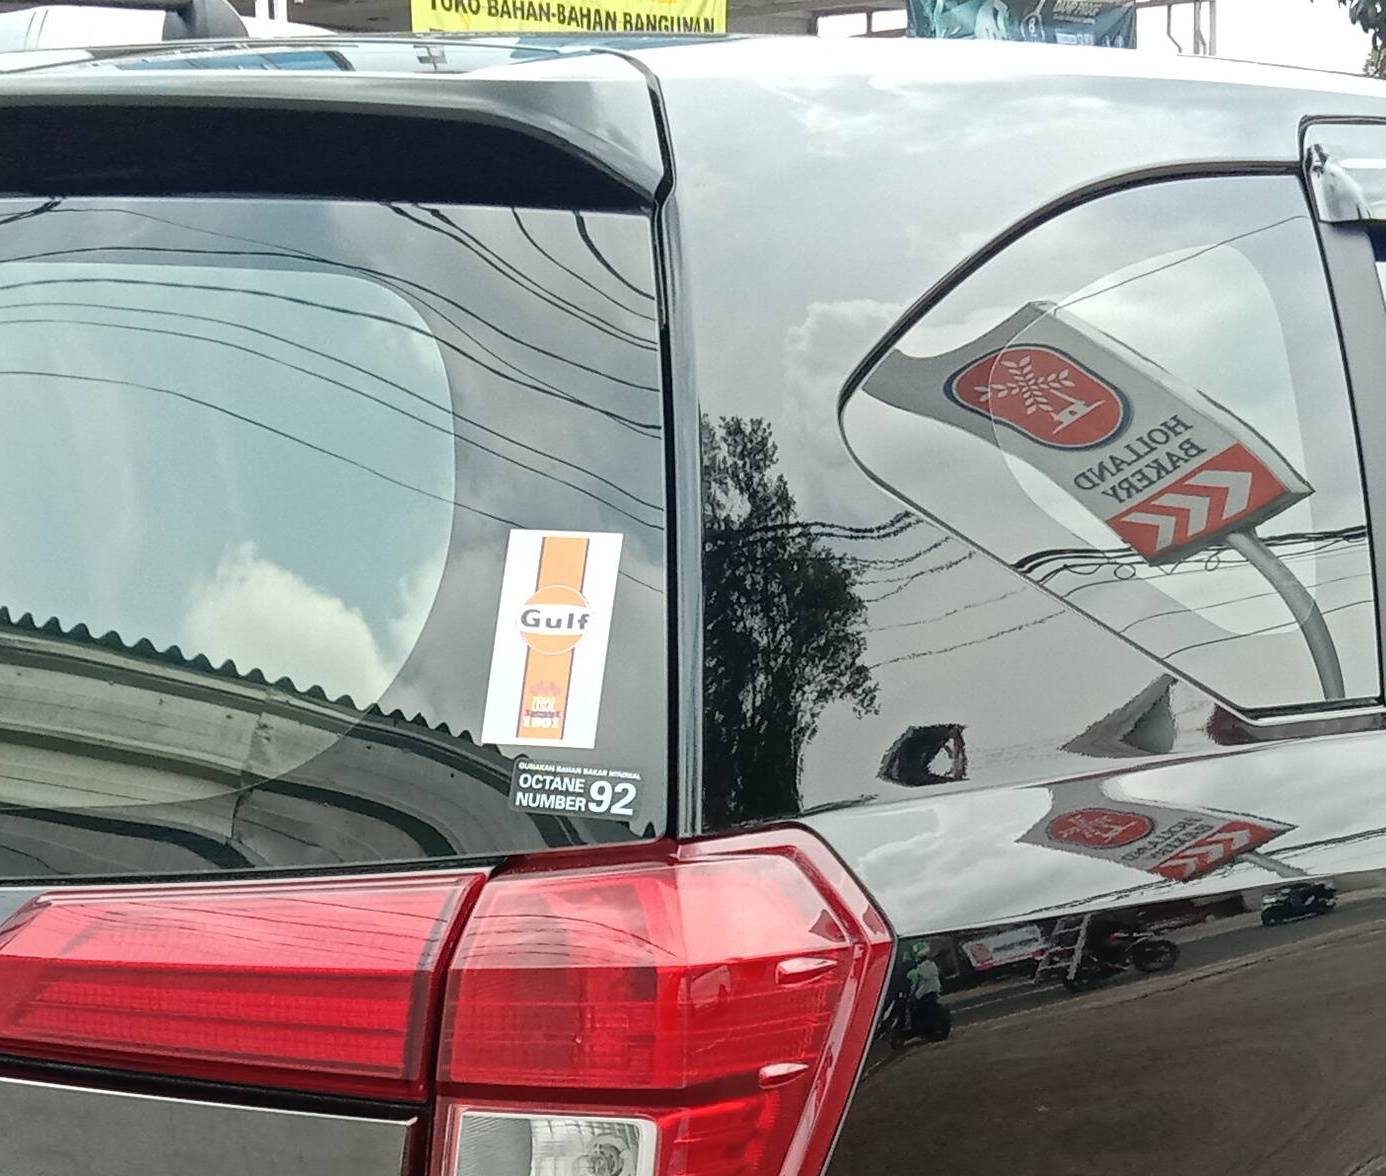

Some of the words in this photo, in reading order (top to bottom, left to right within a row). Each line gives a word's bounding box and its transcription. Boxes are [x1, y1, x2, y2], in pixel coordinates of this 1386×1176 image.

[520, 608, 590, 631] Gulf
[518, 773, 586, 793] OCTANE
[515, 791, 587, 812] NUMBER
[587, 780, 637, 816] 92
